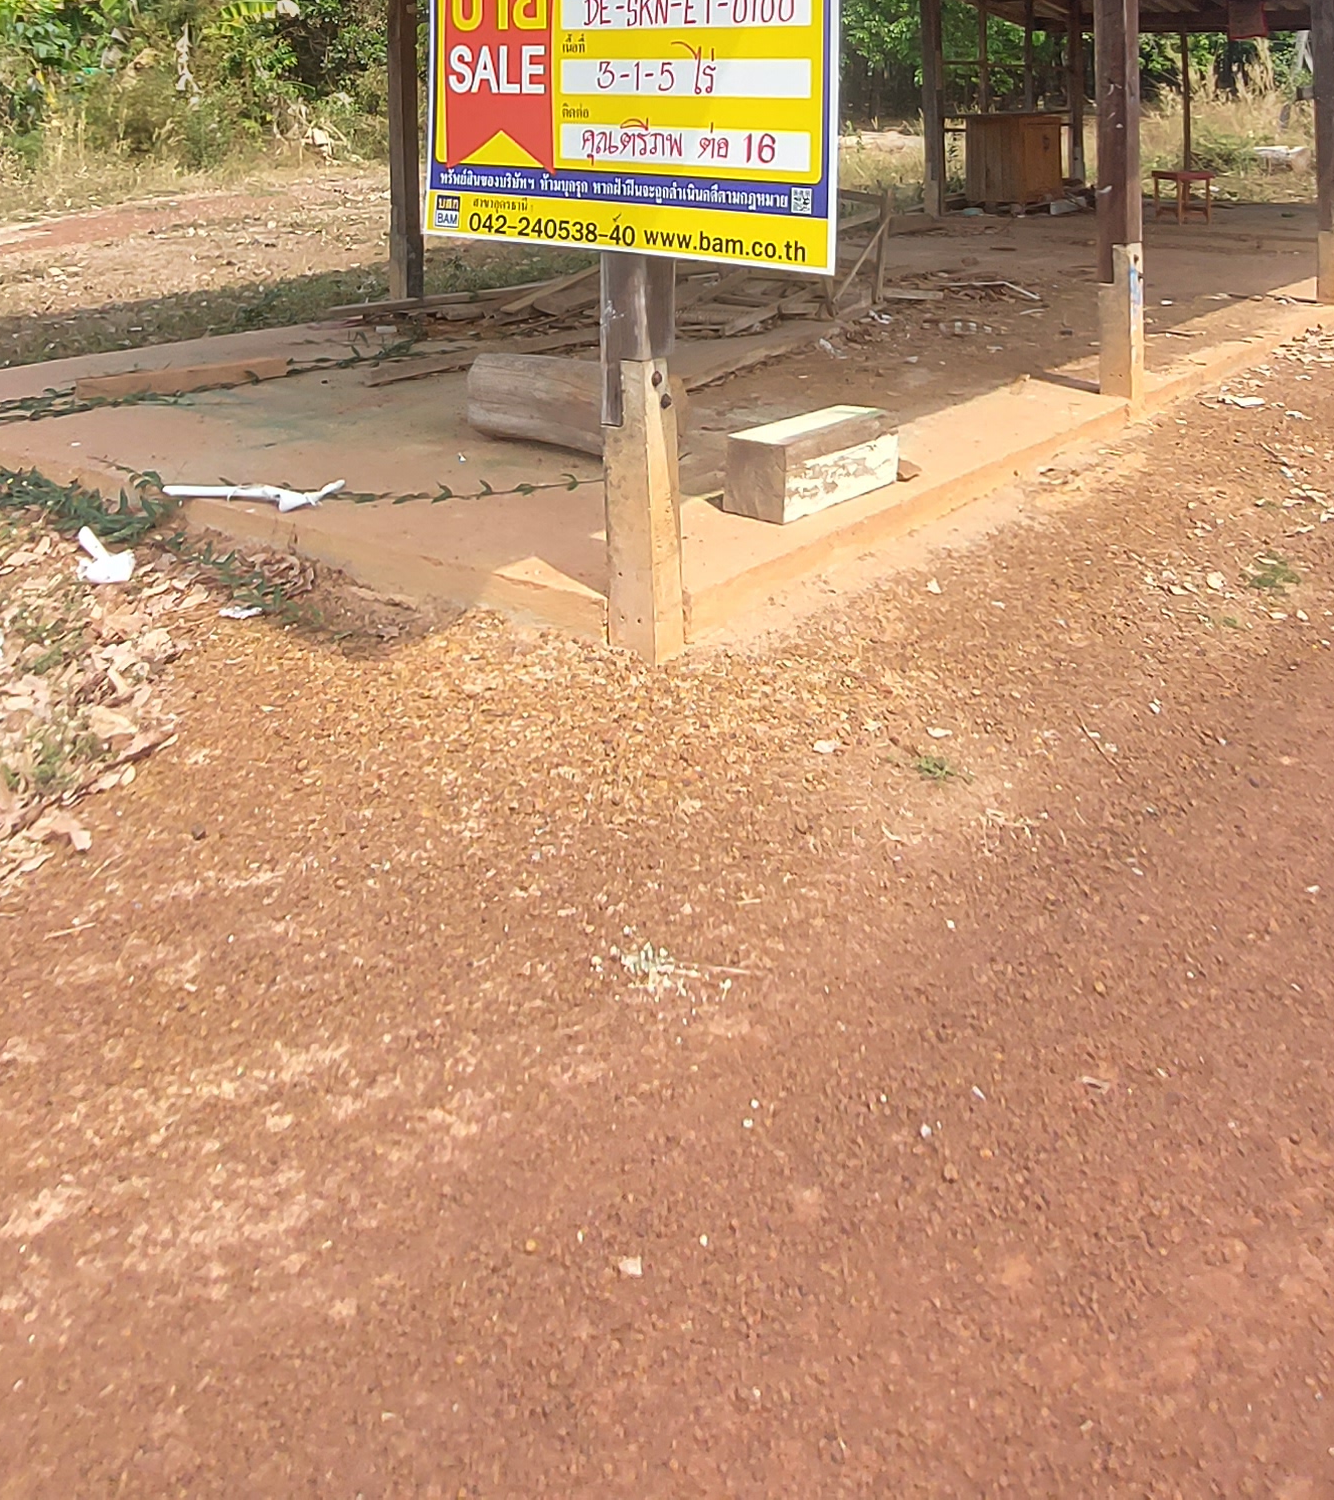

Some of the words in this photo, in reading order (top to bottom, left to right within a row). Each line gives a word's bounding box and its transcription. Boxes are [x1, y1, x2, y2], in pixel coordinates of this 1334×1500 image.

[562, 34, 586, 54] เนื้อที่
[448, 44, 546, 94] SALE
[597, 60, 675, 92] 3-1-5
[671, 41, 716, 94] ไร่
[562, 103, 589, 118] ติดต่อ
[697, 122, 729, 159] ต่อ
[743, 133, 776, 164] 16
[540, 173, 588, 197] ห้ามบุกรุก
[437, 212, 458, 225] BAM
[469, 213, 635, 246] 042-240538-40
[644, 230, 806, 262] www.bam.co.th
